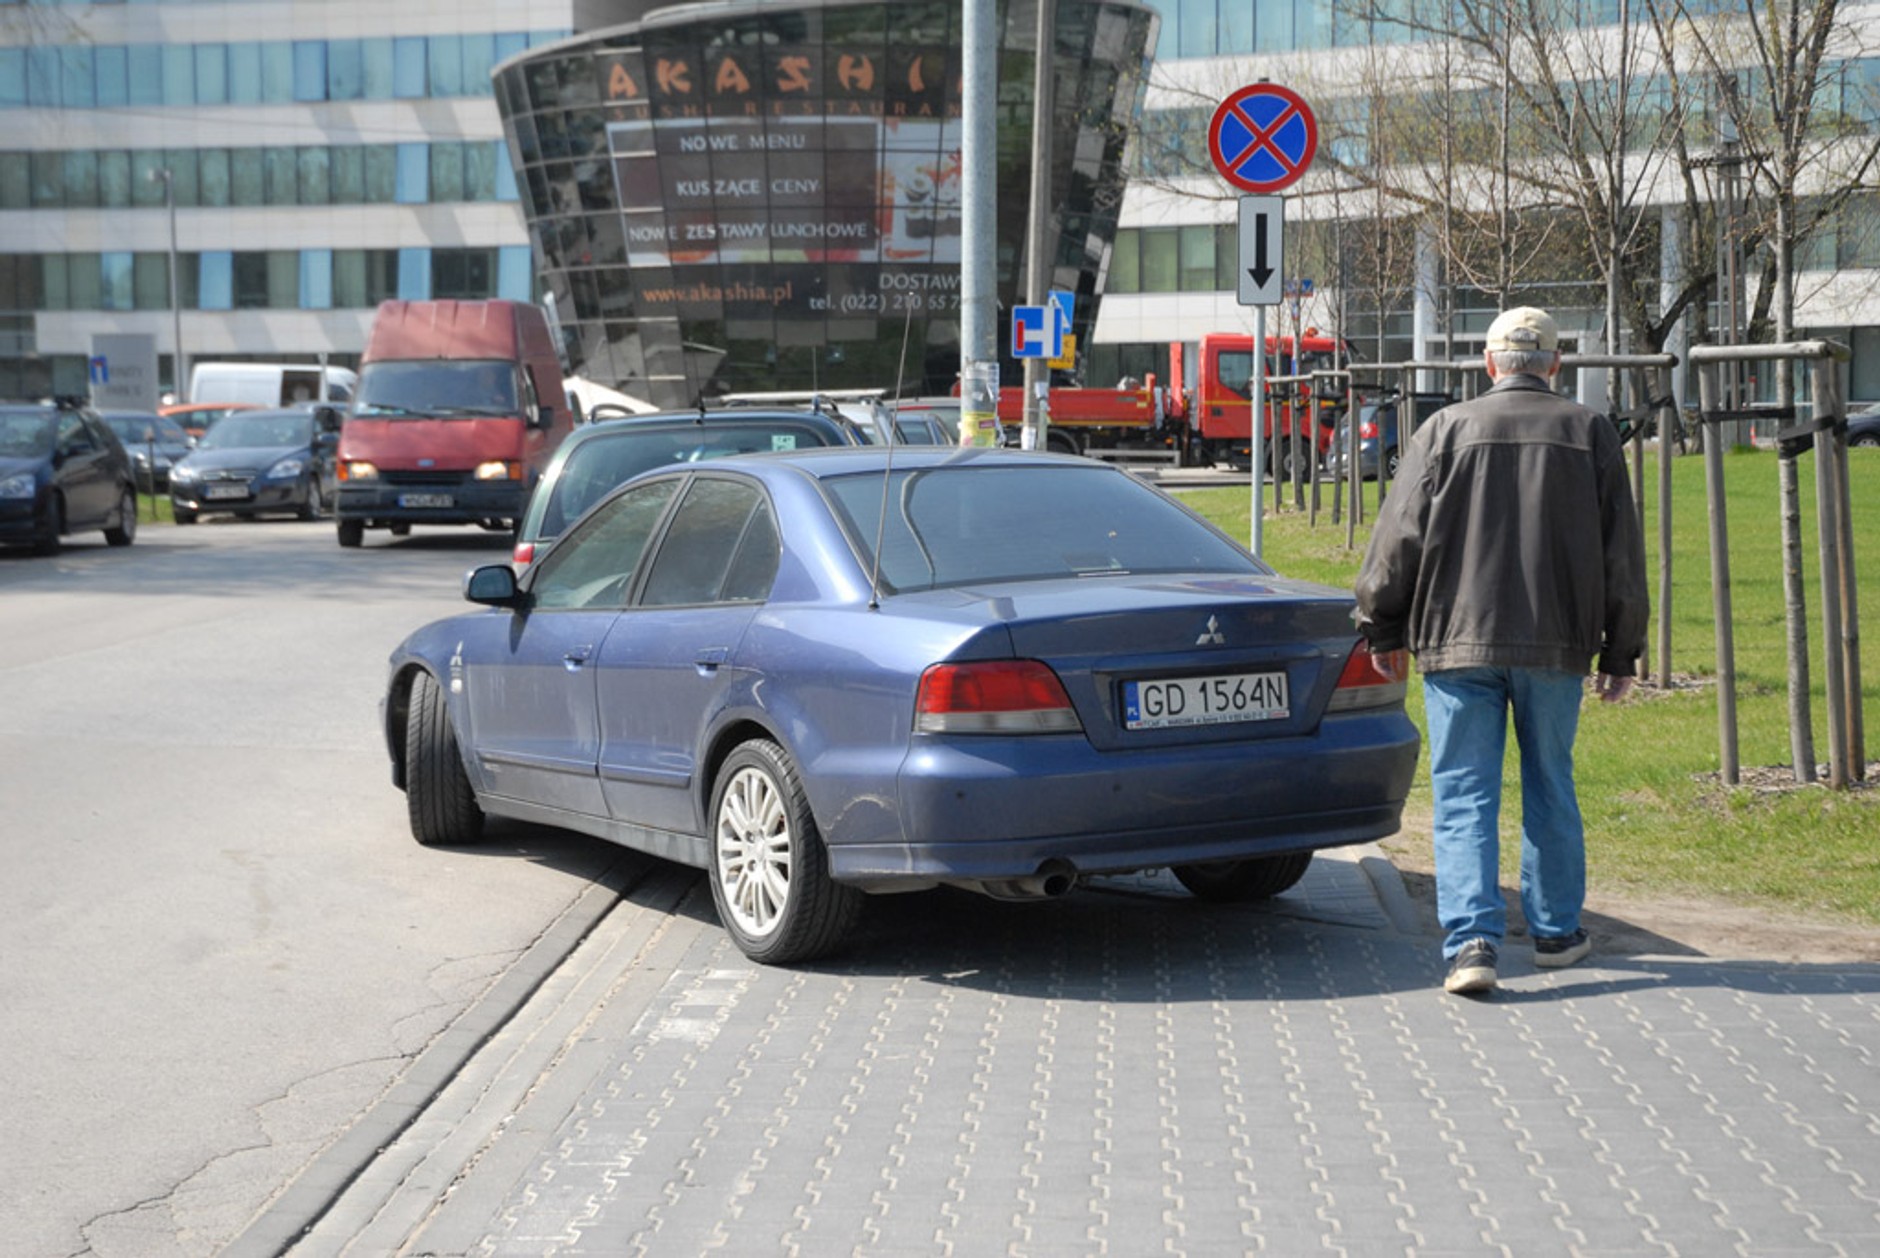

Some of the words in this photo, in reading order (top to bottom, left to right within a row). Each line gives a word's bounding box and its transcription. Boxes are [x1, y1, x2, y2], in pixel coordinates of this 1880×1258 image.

[608, 53, 962, 99] AKASHI
[614, 102, 713, 121] SUSHI
[744, 101, 962, 117] RESTAURAN
[680, 135, 738, 151] NOWE
[750, 134, 806, 149] MENU
[676, 179, 760, 197] KUSZĄCE
[771, 179, 819, 194] CENY
[629, 227, 678, 241] NOWE
[686, 222, 766, 240] ZESTAWY
[771, 222, 868, 238] LUNCHOWE
[879, 273, 961, 290] DOSTAW
[642, 282, 793, 304] www.akashia.pl
[809, 293, 836, 311] tel.
[840, 294, 887, 314] (022)
[950, 295, 962, 310] 7
[1144, 683, 1186, 717] GD
[1199, 676, 1284, 714] 1564N
[1127, 706, 1139, 717] PL
